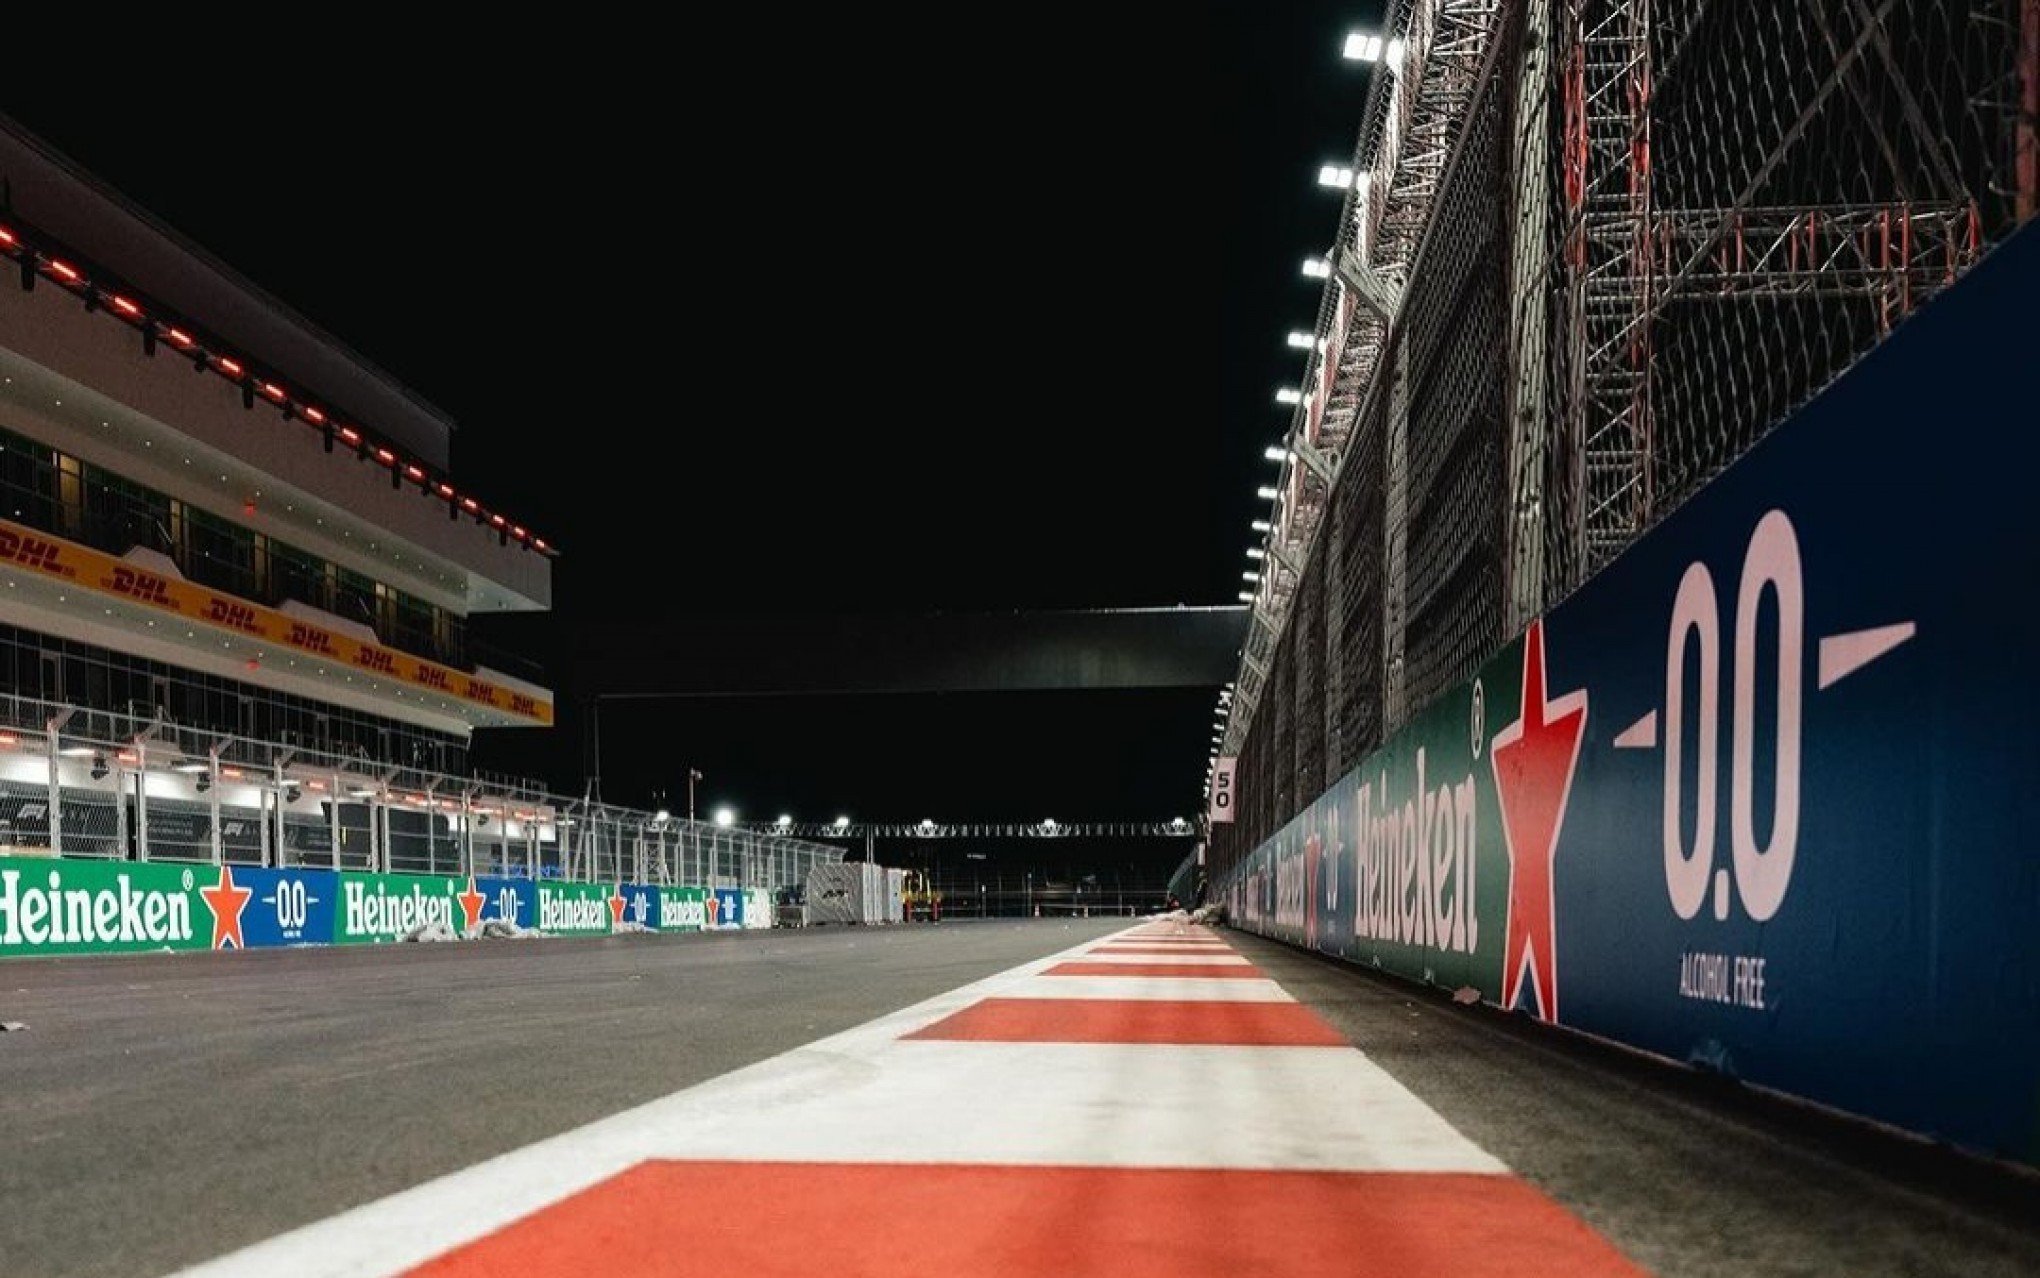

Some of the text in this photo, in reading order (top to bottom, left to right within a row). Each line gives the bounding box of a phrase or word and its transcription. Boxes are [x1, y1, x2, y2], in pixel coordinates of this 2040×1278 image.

[0, 529, 64, 574] DHL
[112, 567, 169, 607] DHL
[210, 598, 260, 634] DHL
[290, 622, 334, 655] DHL
[360, 645, 394, 674] DHL
[418, 664, 451, 691] DHL
[1355, 509, 1804, 954] Heineken 0.0
[1216, 771, 1231, 808] 50
[277, 879, 306, 928] 0.0
[344, 881, 455, 935] Heineken
[538, 888, 607, 930] Heineken
[1680, 953, 1766, 1010] ALCOHOL FREE
